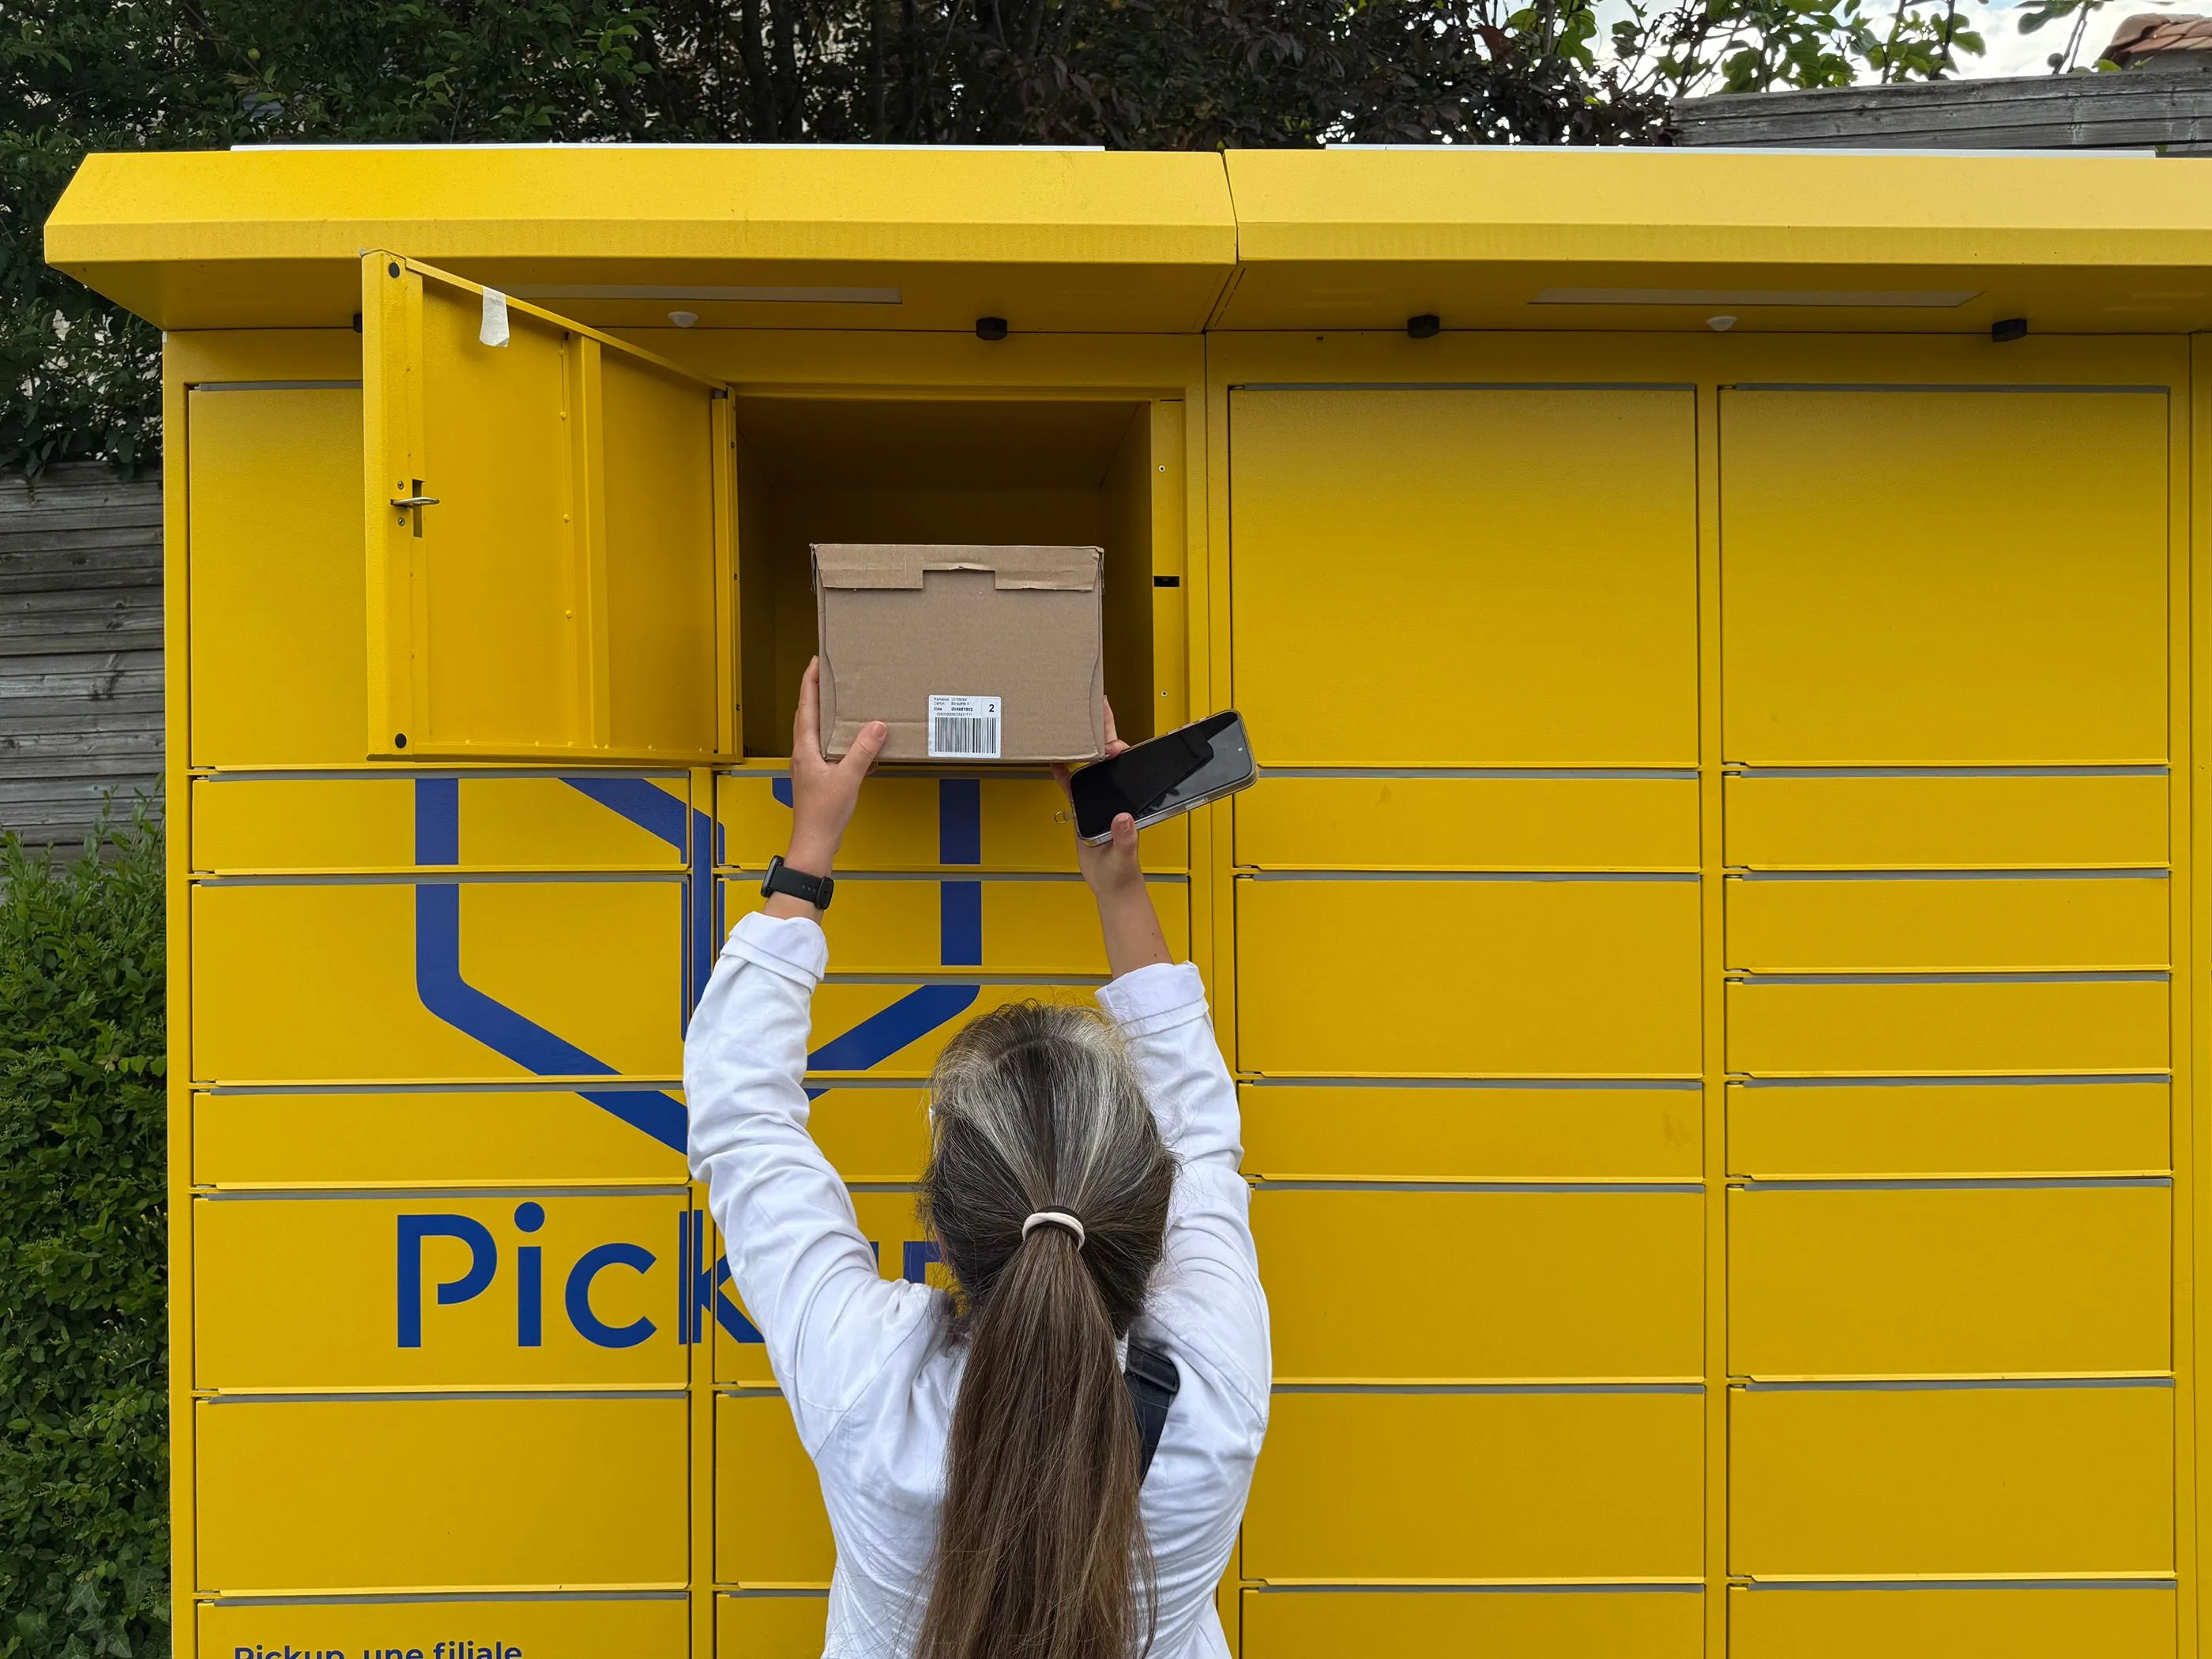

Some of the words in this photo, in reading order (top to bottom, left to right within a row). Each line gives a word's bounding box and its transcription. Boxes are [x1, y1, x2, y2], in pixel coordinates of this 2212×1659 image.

[989, 703, 995, 713] 2
[397, 1202, 945, 1349] Pick
[433, 1641, 523, 1659] filiale
